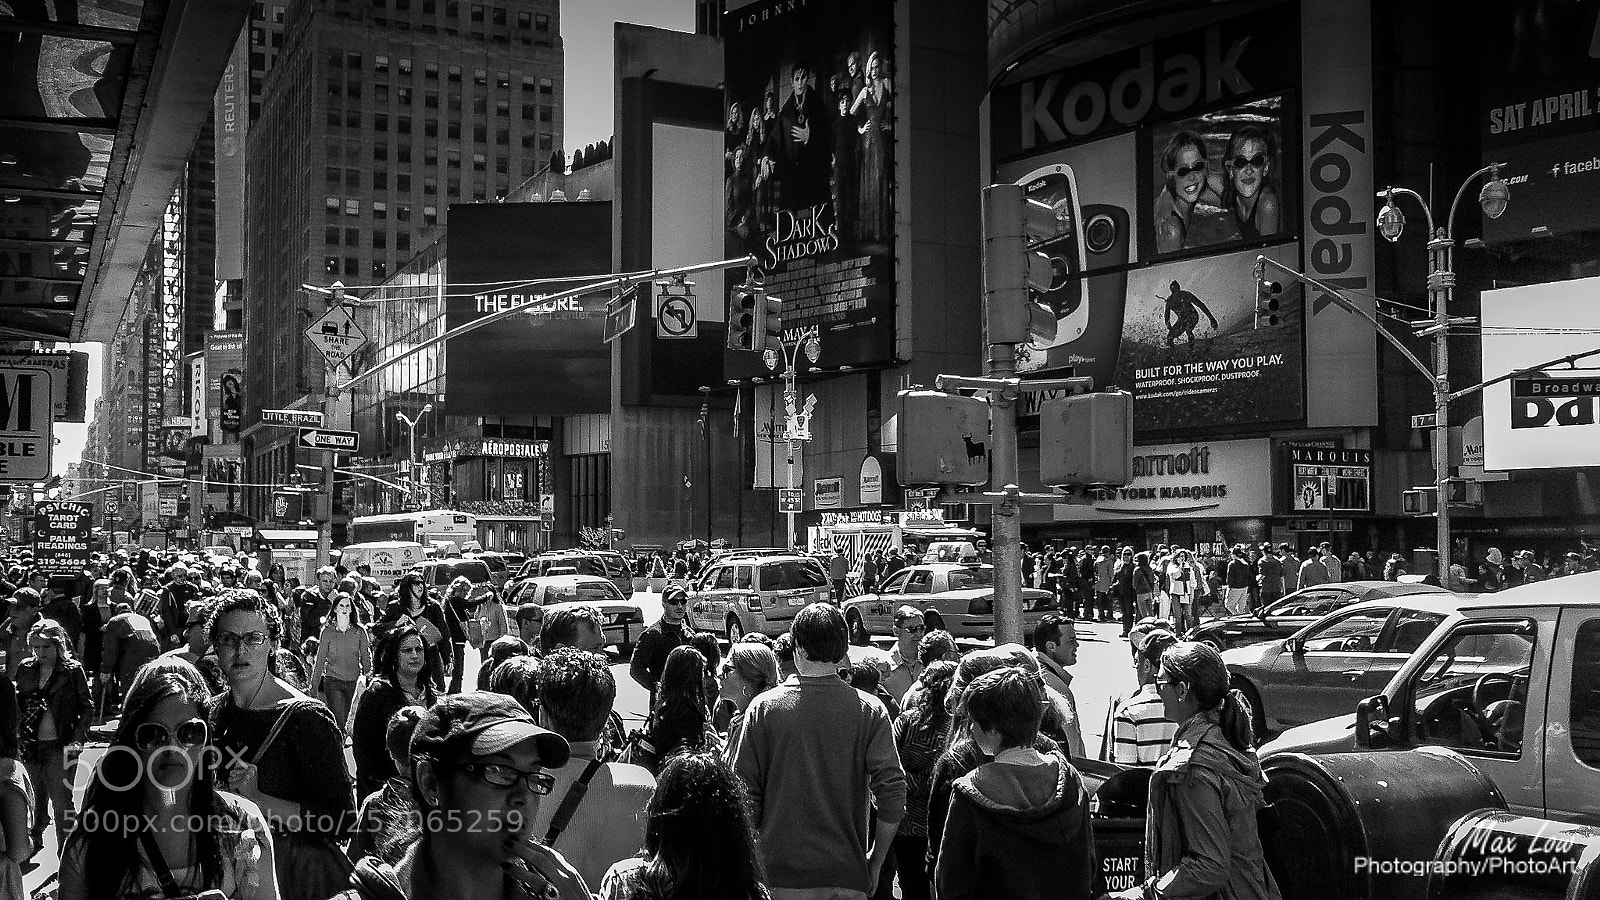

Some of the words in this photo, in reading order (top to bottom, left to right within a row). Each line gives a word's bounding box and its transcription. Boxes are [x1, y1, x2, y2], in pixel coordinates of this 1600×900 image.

[1020, 24, 1255, 149] Kodak
[225, 63, 235, 133] REUTERS
[1490, 102, 1527, 134] SAT
[1531, 89, 1592, 127] APRIL
[1028, 179, 1047, 192] Kodak
[1309, 110, 1368, 316] Kodak
[773, 202, 829, 246] DARK
[764, 223, 839, 270] SHADOWS
[475, 294, 508, 312] THE
[323, 336, 350, 346] SHARE
[326, 350, 346, 359] ROAD
[1135, 367, 1161, 380] BUILT
[1163, 364, 1182, 377] FOR
[1184, 362, 1204, 374] THE
[1205, 360, 1230, 372] WAY
[1231, 357, 1254, 370] YOU
[1256, 353, 1284, 367] PLAY.
[1135, 378, 1177, 389] WATERPROOF.
[1177, 374, 1221, 385] SHOCKPROOF.
[262, 412, 289, 421] LITTLE
[292, 414, 321, 424] BRAZIL
[315, 434, 332, 444] ONE
[335, 436, 353, 446] WAY
[1132, 446, 1211, 478] arriott
[1292, 449, 1370, 463] MARQUIS
[1121, 487, 1157, 501] YORK
[1159, 484, 1228, 500] MARQUIS
[39, 502, 90, 517] PSYCHIC
[48, 514, 80, 522] TAROT
[50, 522, 77, 530] CARD
[37, 542, 88, 550] READINGS
[50, 535, 76, 543] PALM
[1102, 857, 1139, 873] START
[1104, 875, 1135, 891] YOUR
